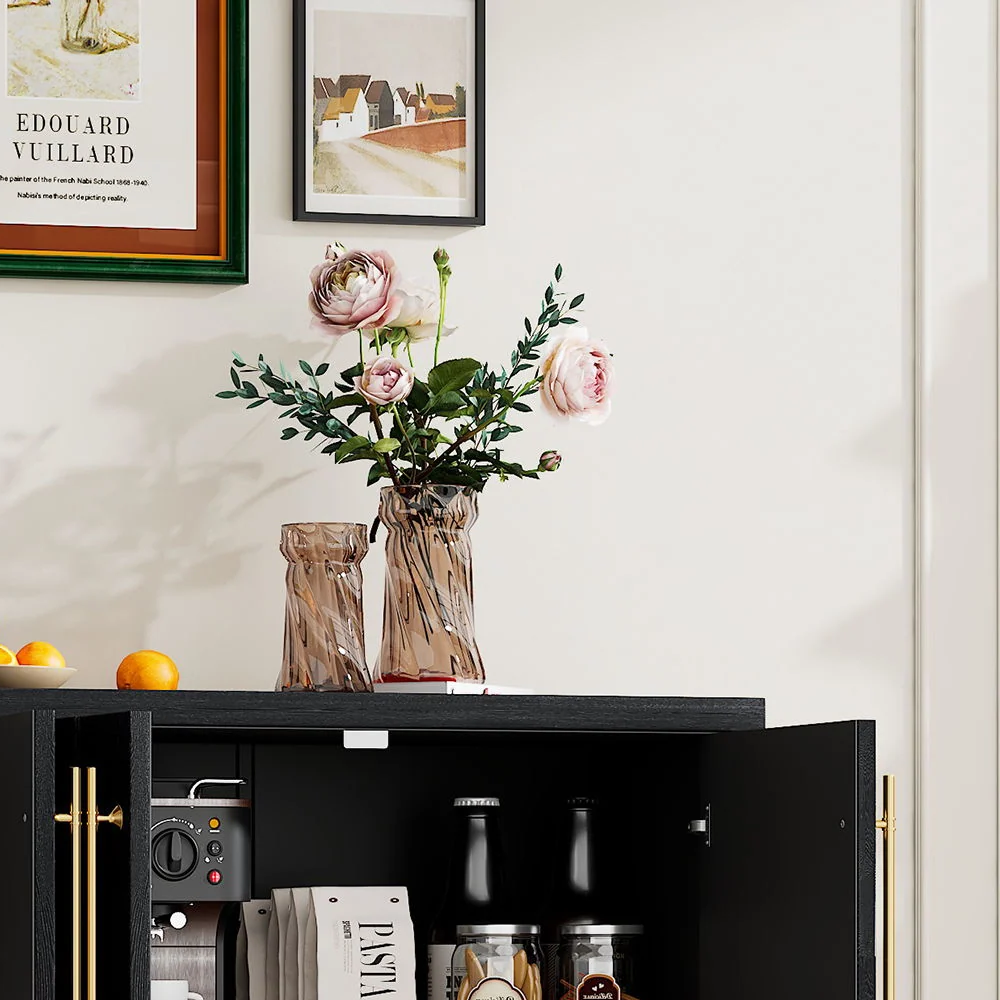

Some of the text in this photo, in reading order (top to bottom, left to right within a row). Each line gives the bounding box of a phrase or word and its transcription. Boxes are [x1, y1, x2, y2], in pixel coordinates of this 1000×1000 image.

[16, 113, 131, 135] EDOUARD
[13, 141, 134, 164] VUILLARD
[76, 194, 106, 202] depicting
[358, 921, 397, 999] PASTA
